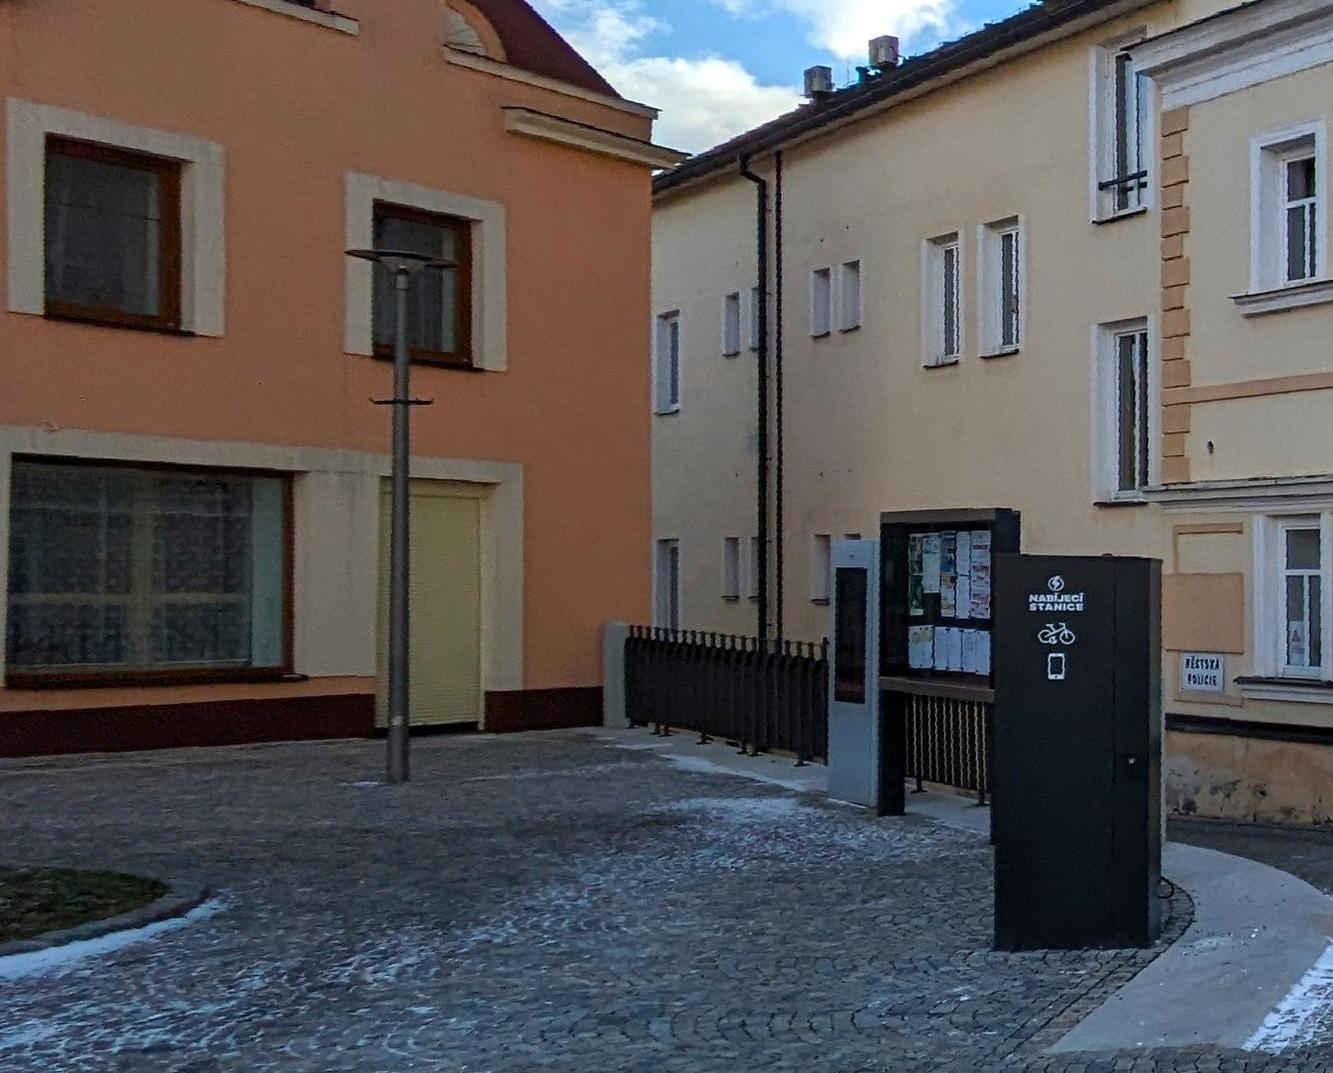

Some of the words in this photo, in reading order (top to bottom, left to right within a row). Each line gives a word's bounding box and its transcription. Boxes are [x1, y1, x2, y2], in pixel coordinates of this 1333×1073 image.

[1028, 592, 1085, 603] NABÍJECÍ
[1028, 602, 1085, 612] STANICE
[1187, 673, 1217, 687] POLICIE
